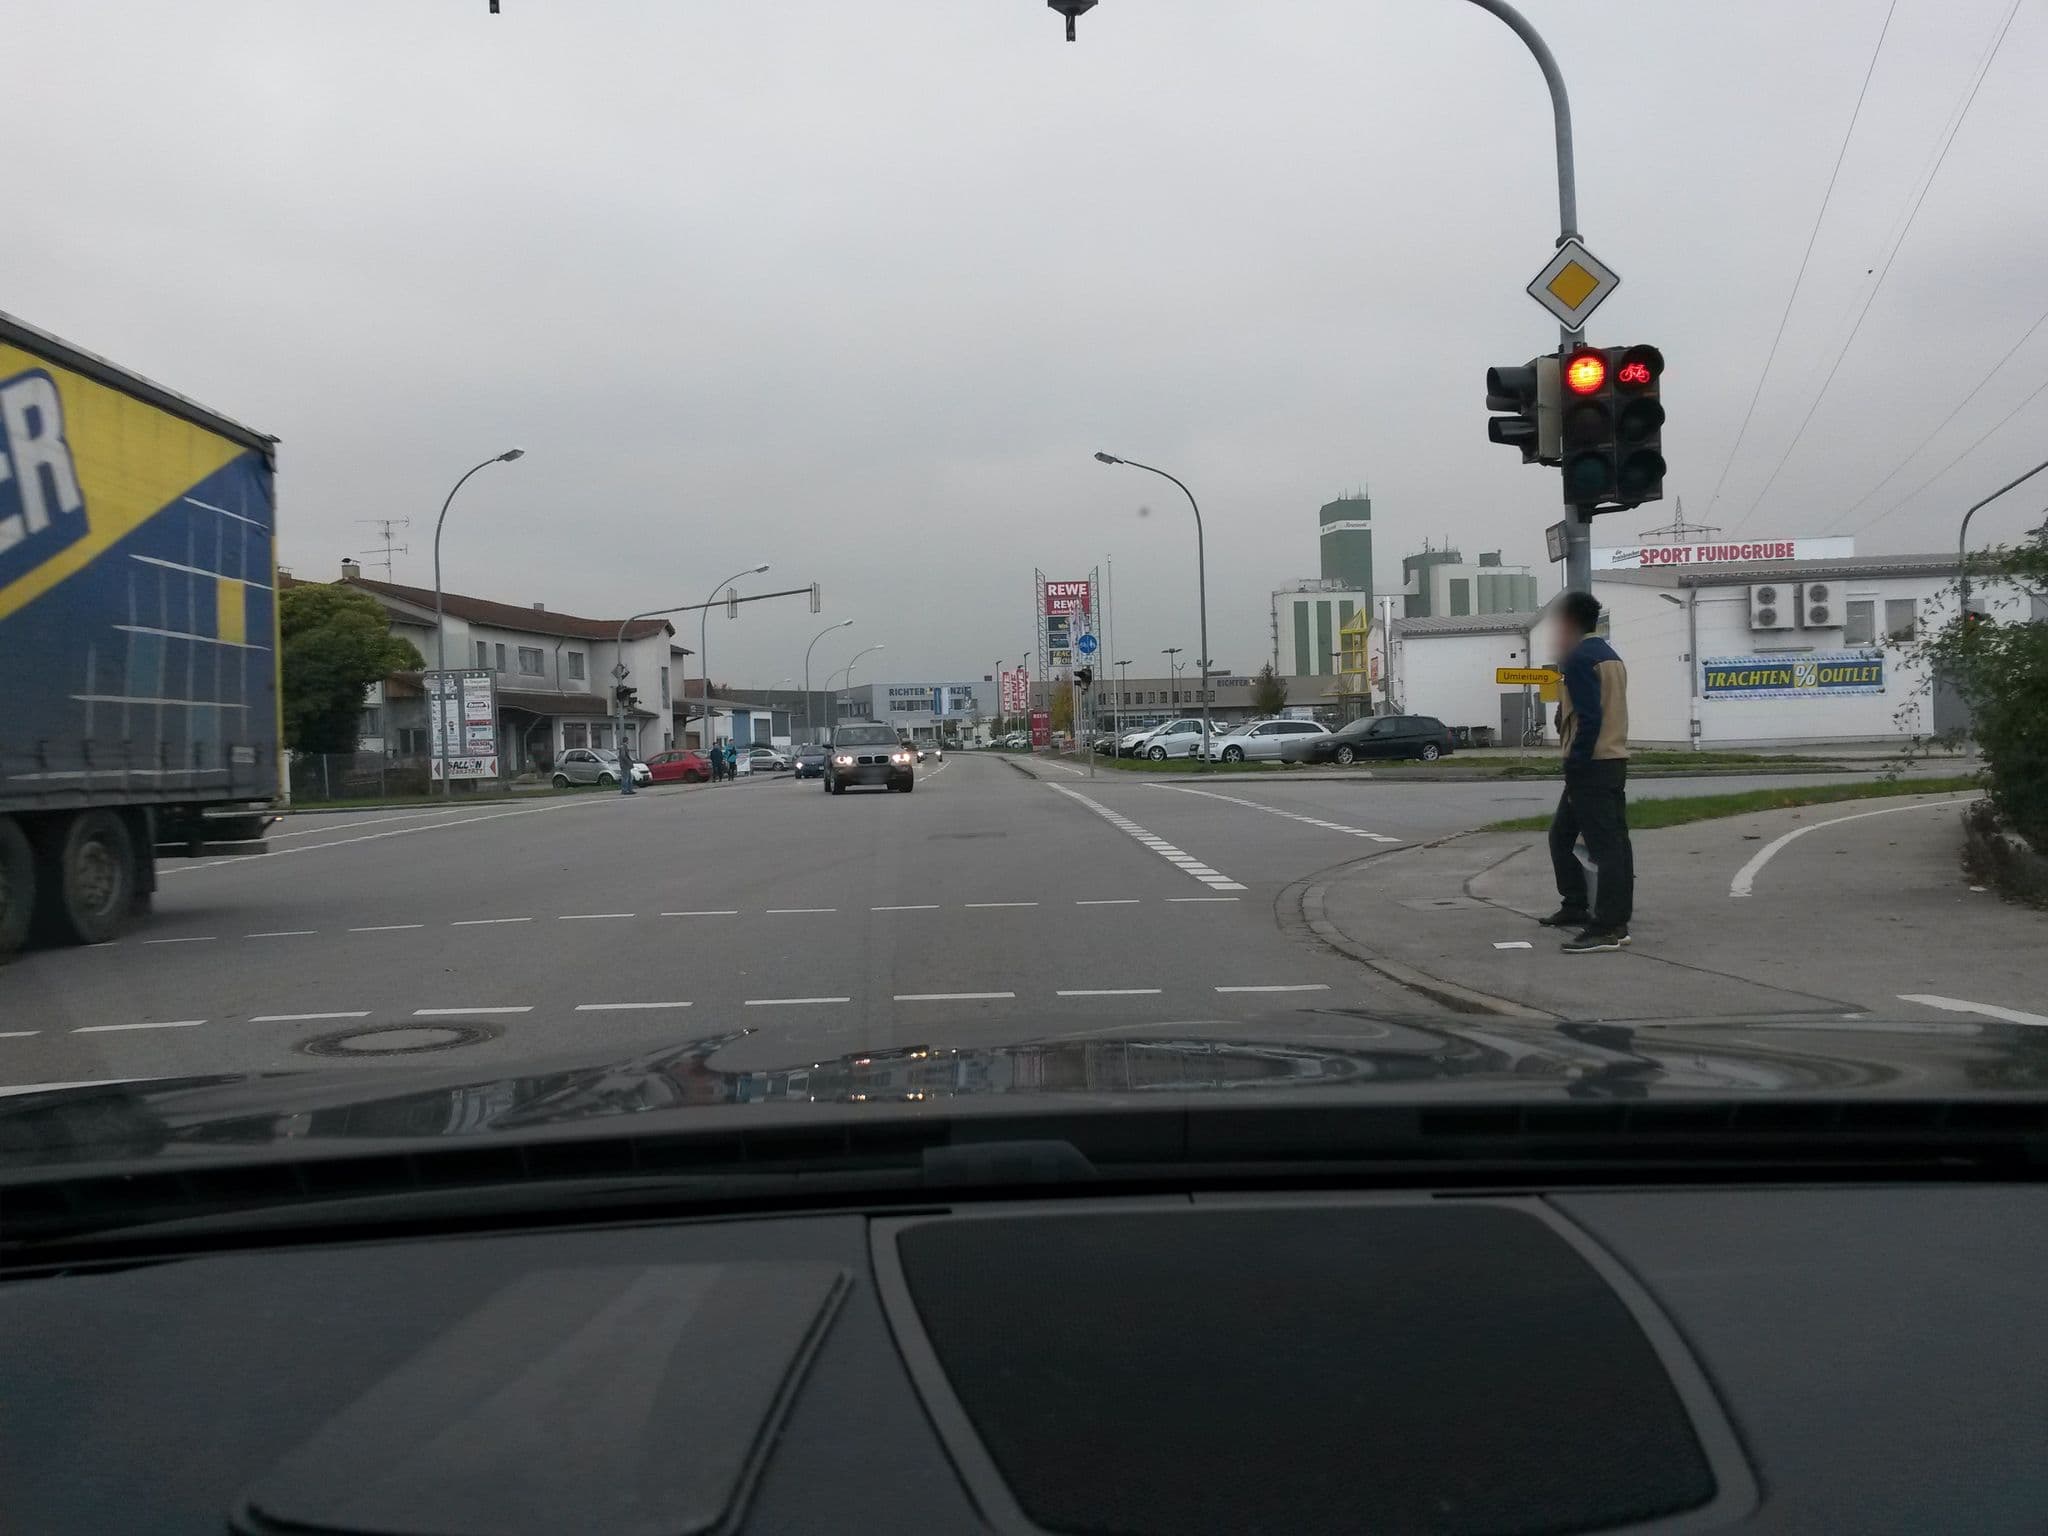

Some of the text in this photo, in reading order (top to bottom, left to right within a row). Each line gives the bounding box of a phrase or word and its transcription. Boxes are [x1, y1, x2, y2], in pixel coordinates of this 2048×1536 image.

[1640, 543, 1794, 564] SPORT FUNDGRUBE
[1048, 584, 1087, 596] REWE
[1503, 672, 1549, 682] Umleitung
[1707, 664, 1880, 687] TRACHTEN % OUTLET
[889, 688, 925, 696] RICHTER
